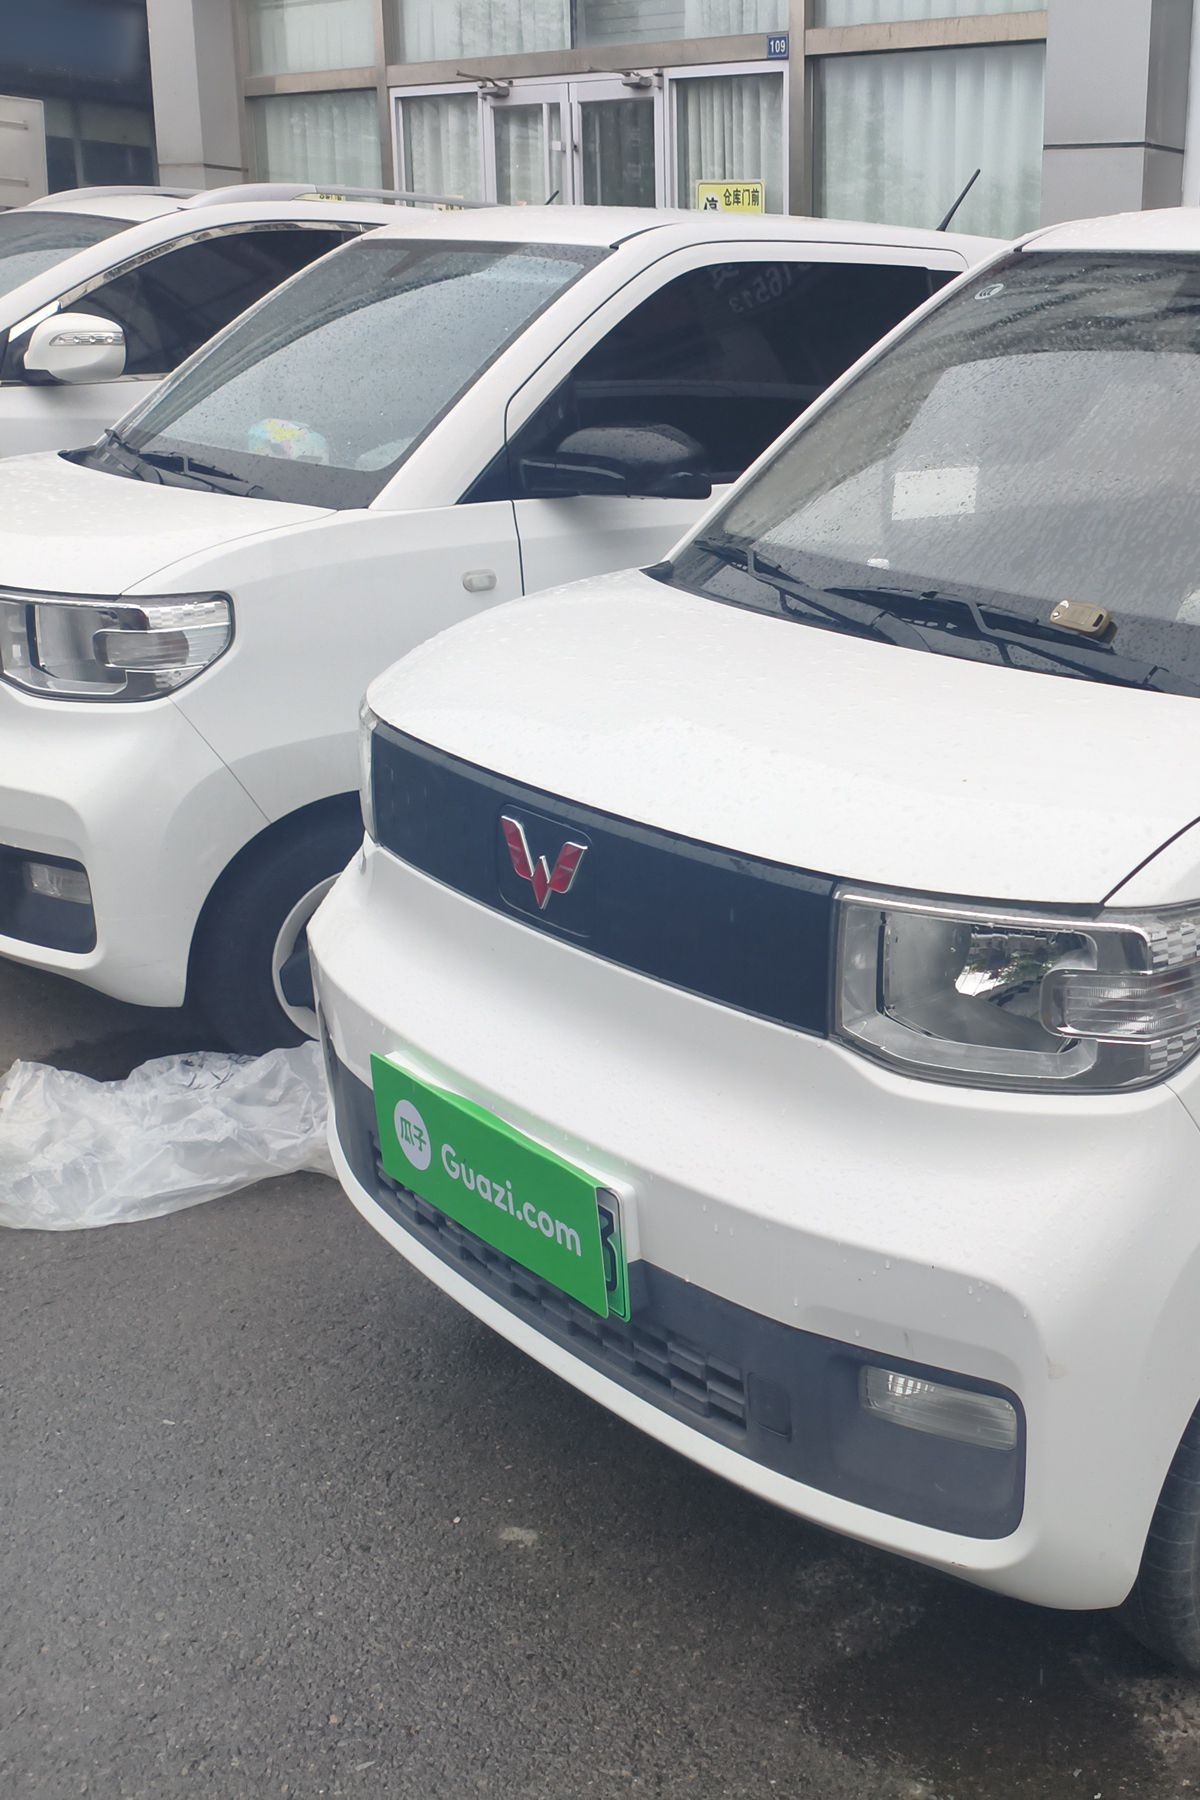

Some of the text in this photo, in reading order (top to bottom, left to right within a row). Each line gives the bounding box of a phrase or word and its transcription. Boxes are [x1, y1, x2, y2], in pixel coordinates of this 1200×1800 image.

[769, 39, 786, 54] 109
[723, 188, 760, 207] 仓库门前
